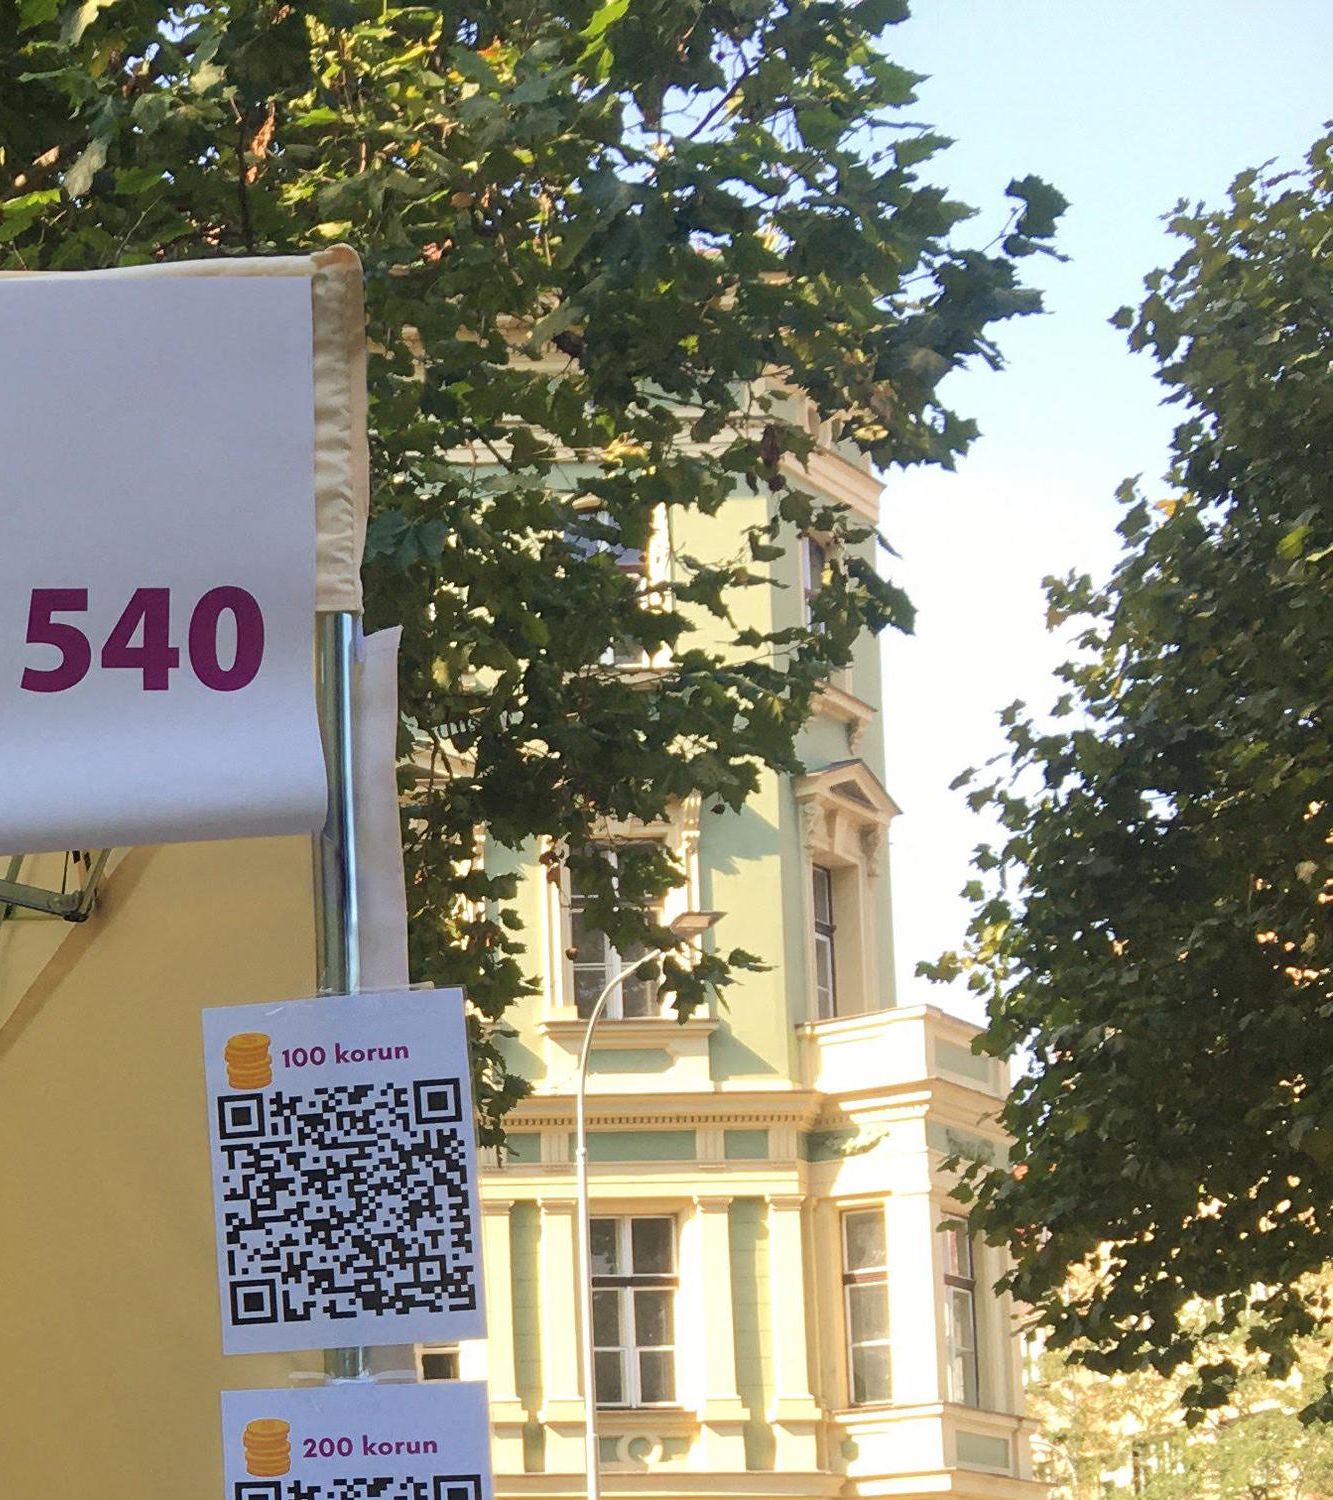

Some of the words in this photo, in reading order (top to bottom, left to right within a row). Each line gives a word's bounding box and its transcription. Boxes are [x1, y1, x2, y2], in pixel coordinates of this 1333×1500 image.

[20, 585, 265, 693] 540
[282, 1045, 326, 1068] 100
[334, 1042, 410, 1065] korun
[303, 1437, 353, 1459] 200
[363, 1434, 438, 1457] korun
